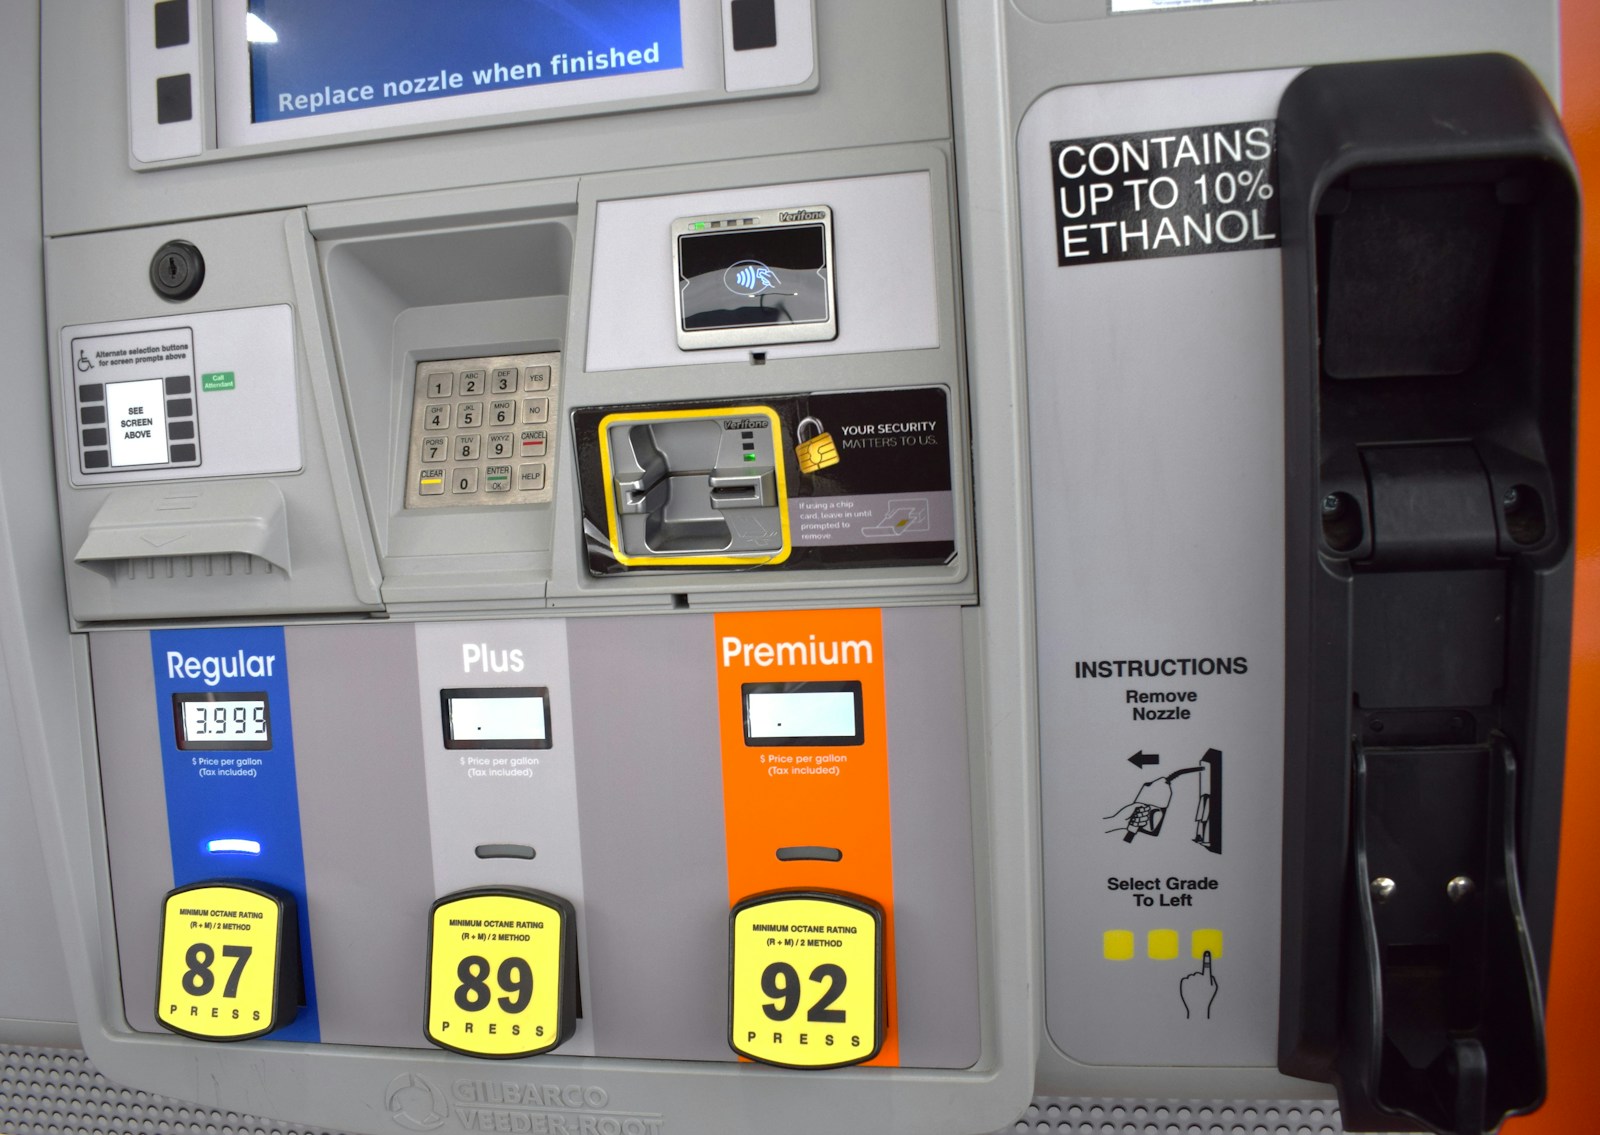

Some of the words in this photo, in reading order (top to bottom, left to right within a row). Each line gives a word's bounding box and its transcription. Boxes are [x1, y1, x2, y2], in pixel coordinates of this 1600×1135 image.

[279, 84, 374, 112] Replace
[383, 70, 463, 97] nozzle
[472, 60, 542, 85] when
[550, 42, 660, 75] finished
[1058, 127, 1271, 179] CONTAINS
[1060, 183, 1113, 218] UP
[1123, 176, 1178, 211] TO
[1194, 169, 1274, 205] 10%
[779, 210, 825, 222] Verifone
[1063, 209, 1276, 258] ETHANOL
[96, 350, 127, 358] Alternate
[129, 346, 160, 355] selection
[135, 355, 163, 364] prompts
[436, 384, 441, 394] 1
[467, 381, 475, 392] 2
[500, 379, 507, 389] 3
[128, 407, 144, 415] SEE
[498, 411, 505, 422] 6
[121, 418, 153, 428] SCREEN
[432, 415, 440, 426] 4
[465, 413, 472, 424] 5
[724, 419, 768, 430] Verifone
[842, 425, 875, 436] YOUR
[878, 421, 936, 433] SECURITY
[124, 430, 151, 439] ABOVE
[843, 438, 897, 449] MATTERS
[901, 437, 914, 446] TO
[918, 436, 938, 445] US.
[430, 448, 437, 458] 7
[463, 446, 470, 456] 8
[495, 444, 503, 454] 9
[460, 479, 468, 490] 0
[722, 634, 873, 667] Premium
[462, 643, 525, 673] Plus
[167, 650, 275, 686] Regular
[1075, 657, 1248, 678] INSTRUCTIONS
[1126, 690, 1198, 704] Remove
[1133, 707, 1191, 721] Nozzle
[236, 758, 262, 767] gallon
[460, 757, 465, 765] $
[468, 757, 490, 765] Price
[493, 758, 508, 766] per
[510, 757, 539, 766] gallon
[760, 754, 765, 764] $
[768, 755, 793, 763] Price
[796, 756, 812, 764] per
[816, 754, 847, 764] gallon
[199, 768, 216, 777] (Tax
[218, 768, 257, 777] included)
[468, 768, 487, 778] (Tax
[489, 768, 533, 777] included)
[768, 766, 788, 776] (Tax
[792, 765, 839, 776] included)
[1107, 877, 1161, 891] Select
[1166, 876, 1218, 890] Grade
[1133, 894, 1154, 907] To
[1160, 893, 1192, 907] Left
[182, 943, 252, 998] 87
[454, 955, 534, 1014] 89
[761, 962, 847, 1023] 92
[453, 1079, 609, 1108] GILBARCO
[455, 1109, 664, 1135] VEEDER-ROOT
